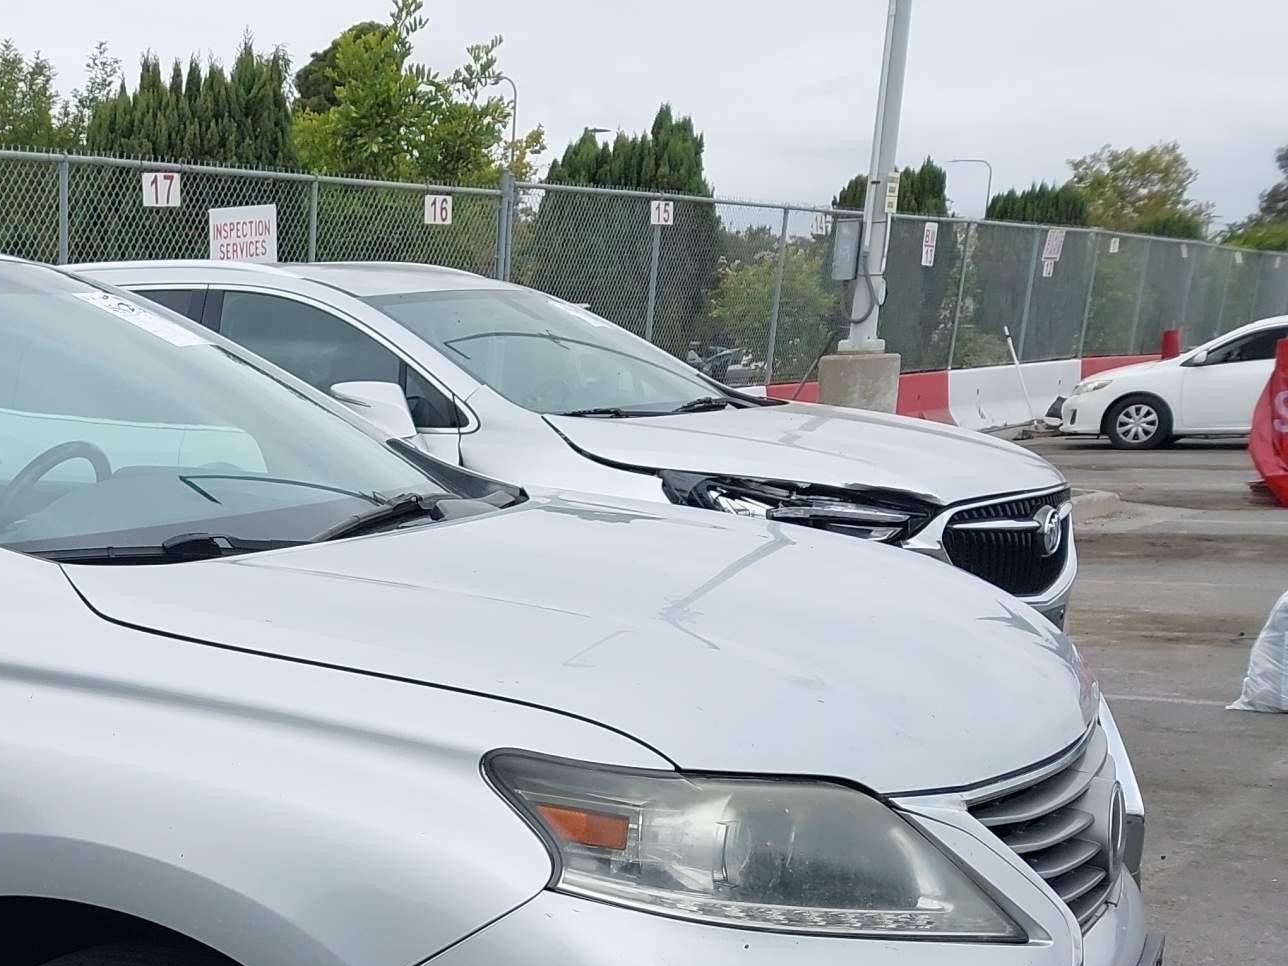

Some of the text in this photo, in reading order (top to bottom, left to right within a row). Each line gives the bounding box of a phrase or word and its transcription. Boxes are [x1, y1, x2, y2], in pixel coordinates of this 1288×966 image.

[150, 174, 174, 205] 17
[431, 198, 448, 222] 16
[656, 202, 670, 223] 15
[213, 219, 271, 240] INSPECTION
[219, 240, 267, 261] SERVICES
